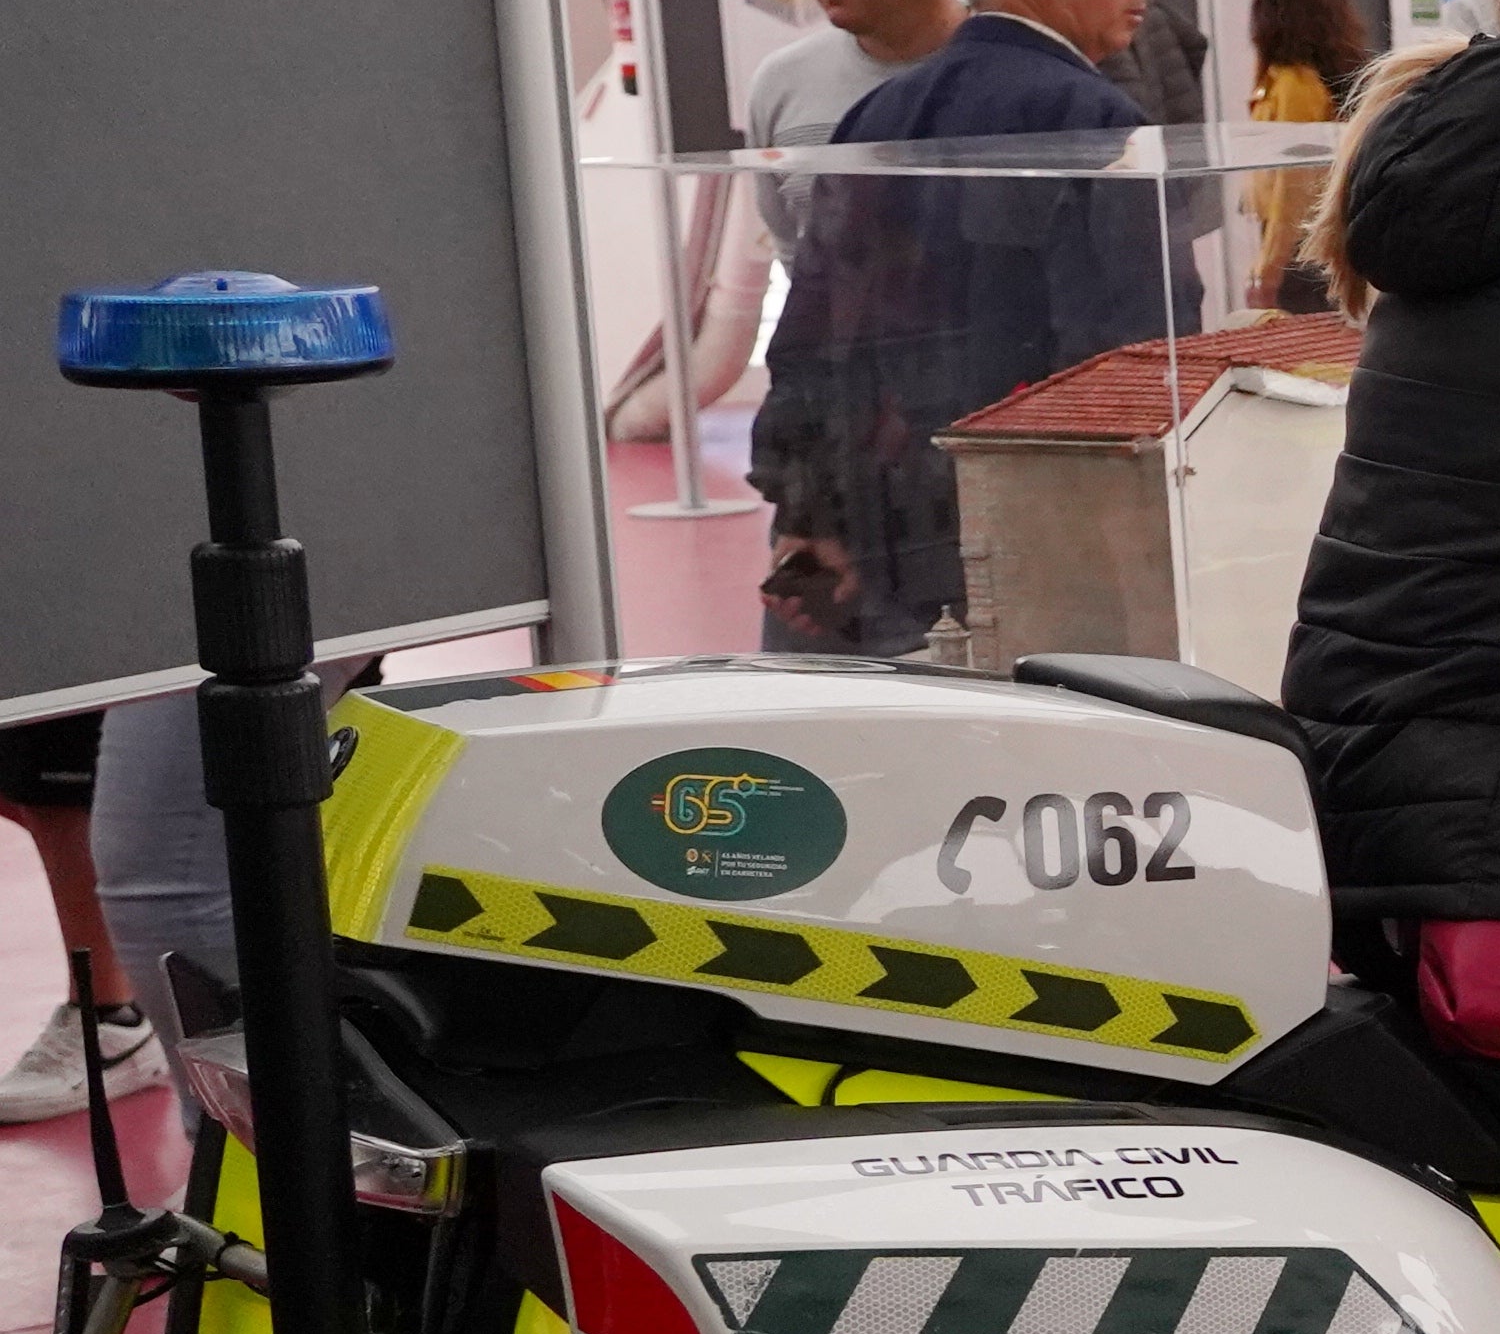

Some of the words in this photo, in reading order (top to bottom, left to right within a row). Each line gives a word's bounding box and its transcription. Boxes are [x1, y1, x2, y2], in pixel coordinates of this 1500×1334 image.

[1023, 791, 1196, 891] 062
[851, 1148, 1102, 1178] GUARDIA
[1115, 1147, 1239, 1166] CIVIL
[951, 1174, 1185, 1208] TRÁFICO
